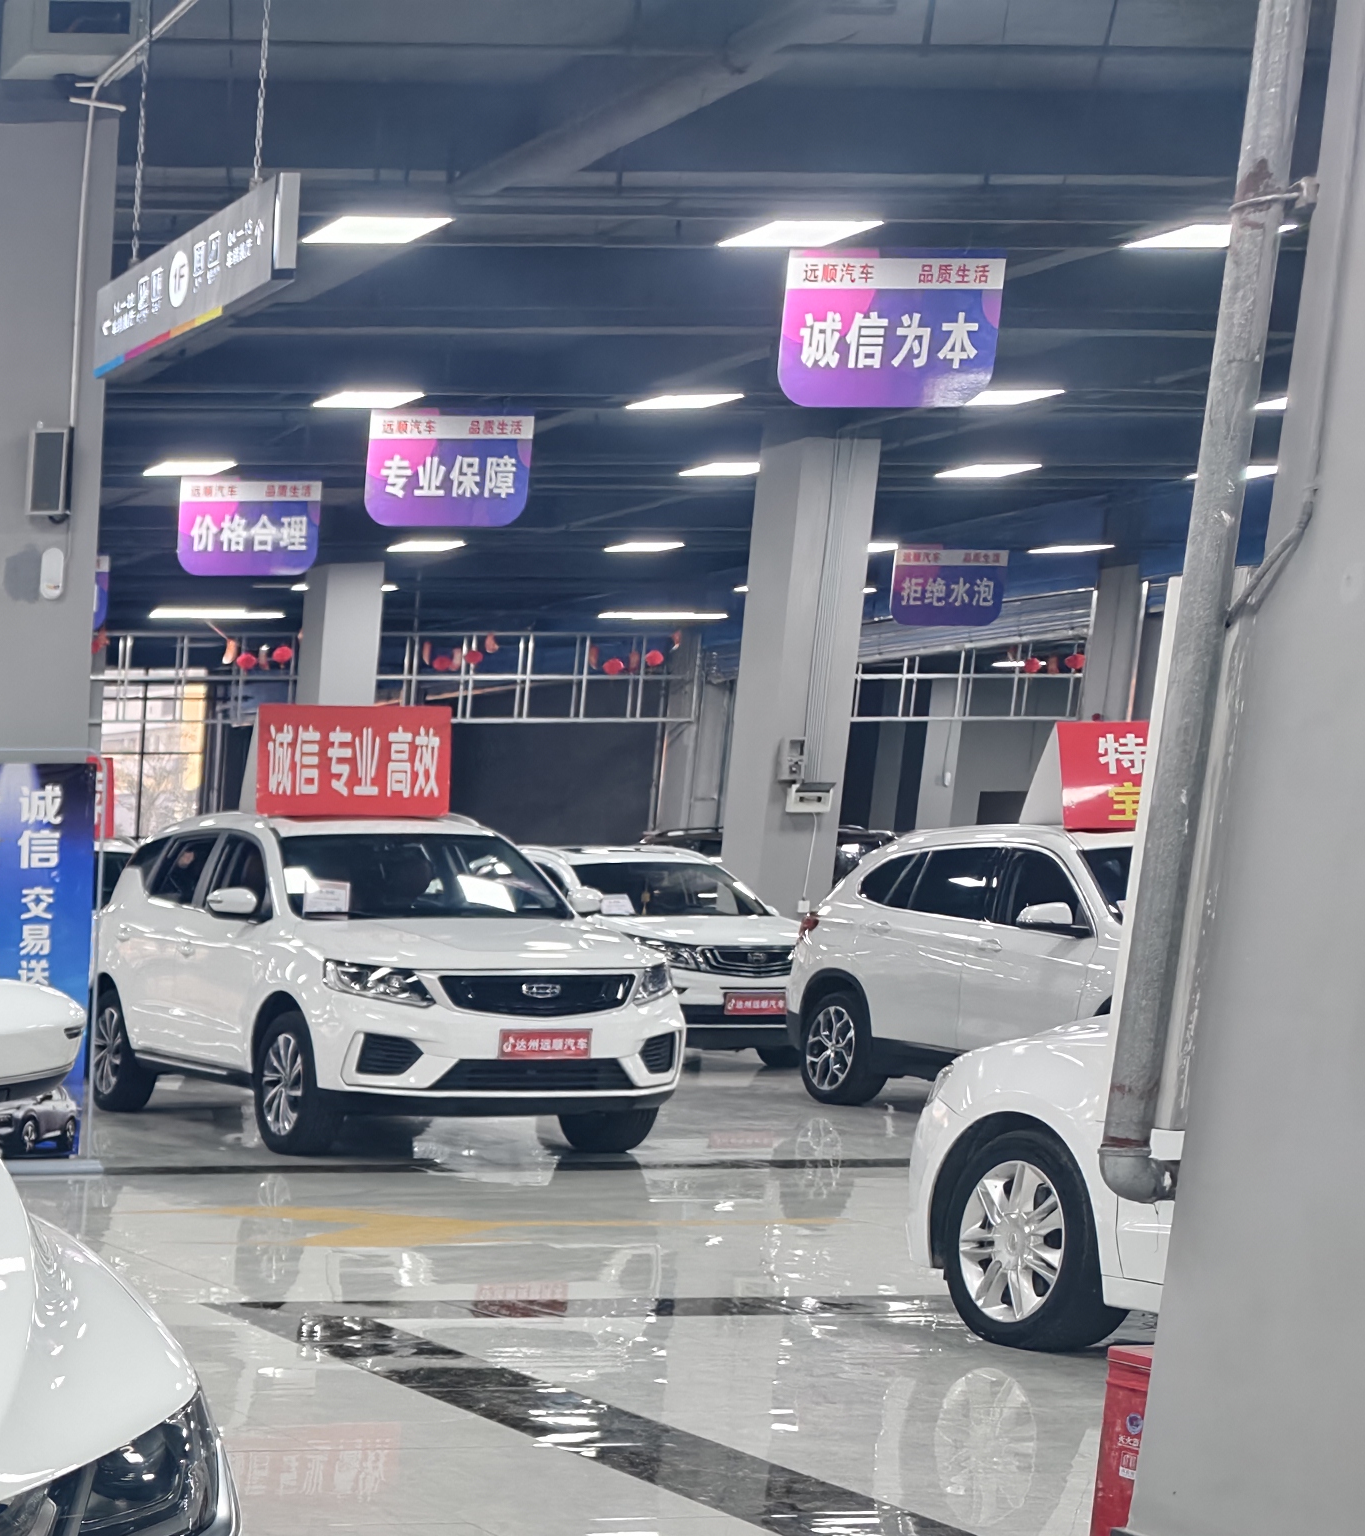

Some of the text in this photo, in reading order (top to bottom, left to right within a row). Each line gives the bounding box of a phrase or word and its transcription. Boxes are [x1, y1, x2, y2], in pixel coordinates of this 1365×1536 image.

[803, 263, 990, 284] 远顺汽车 品质生活
[800, 311, 979, 369] 诚信为本
[382, 419, 523, 435] 远顺汽车 品质生活
[380, 454, 517, 499] 专业保障
[190, 513, 308, 552] 价格合理
[901, 577, 994, 606] 拒绝水泡
[268, 723, 440, 798] 诚信 专业 高效
[1098, 733, 1147, 775] 特
[17, 783, 63, 869] 诚信
[516, 1037, 588, 1051] 达州远顺汽车
